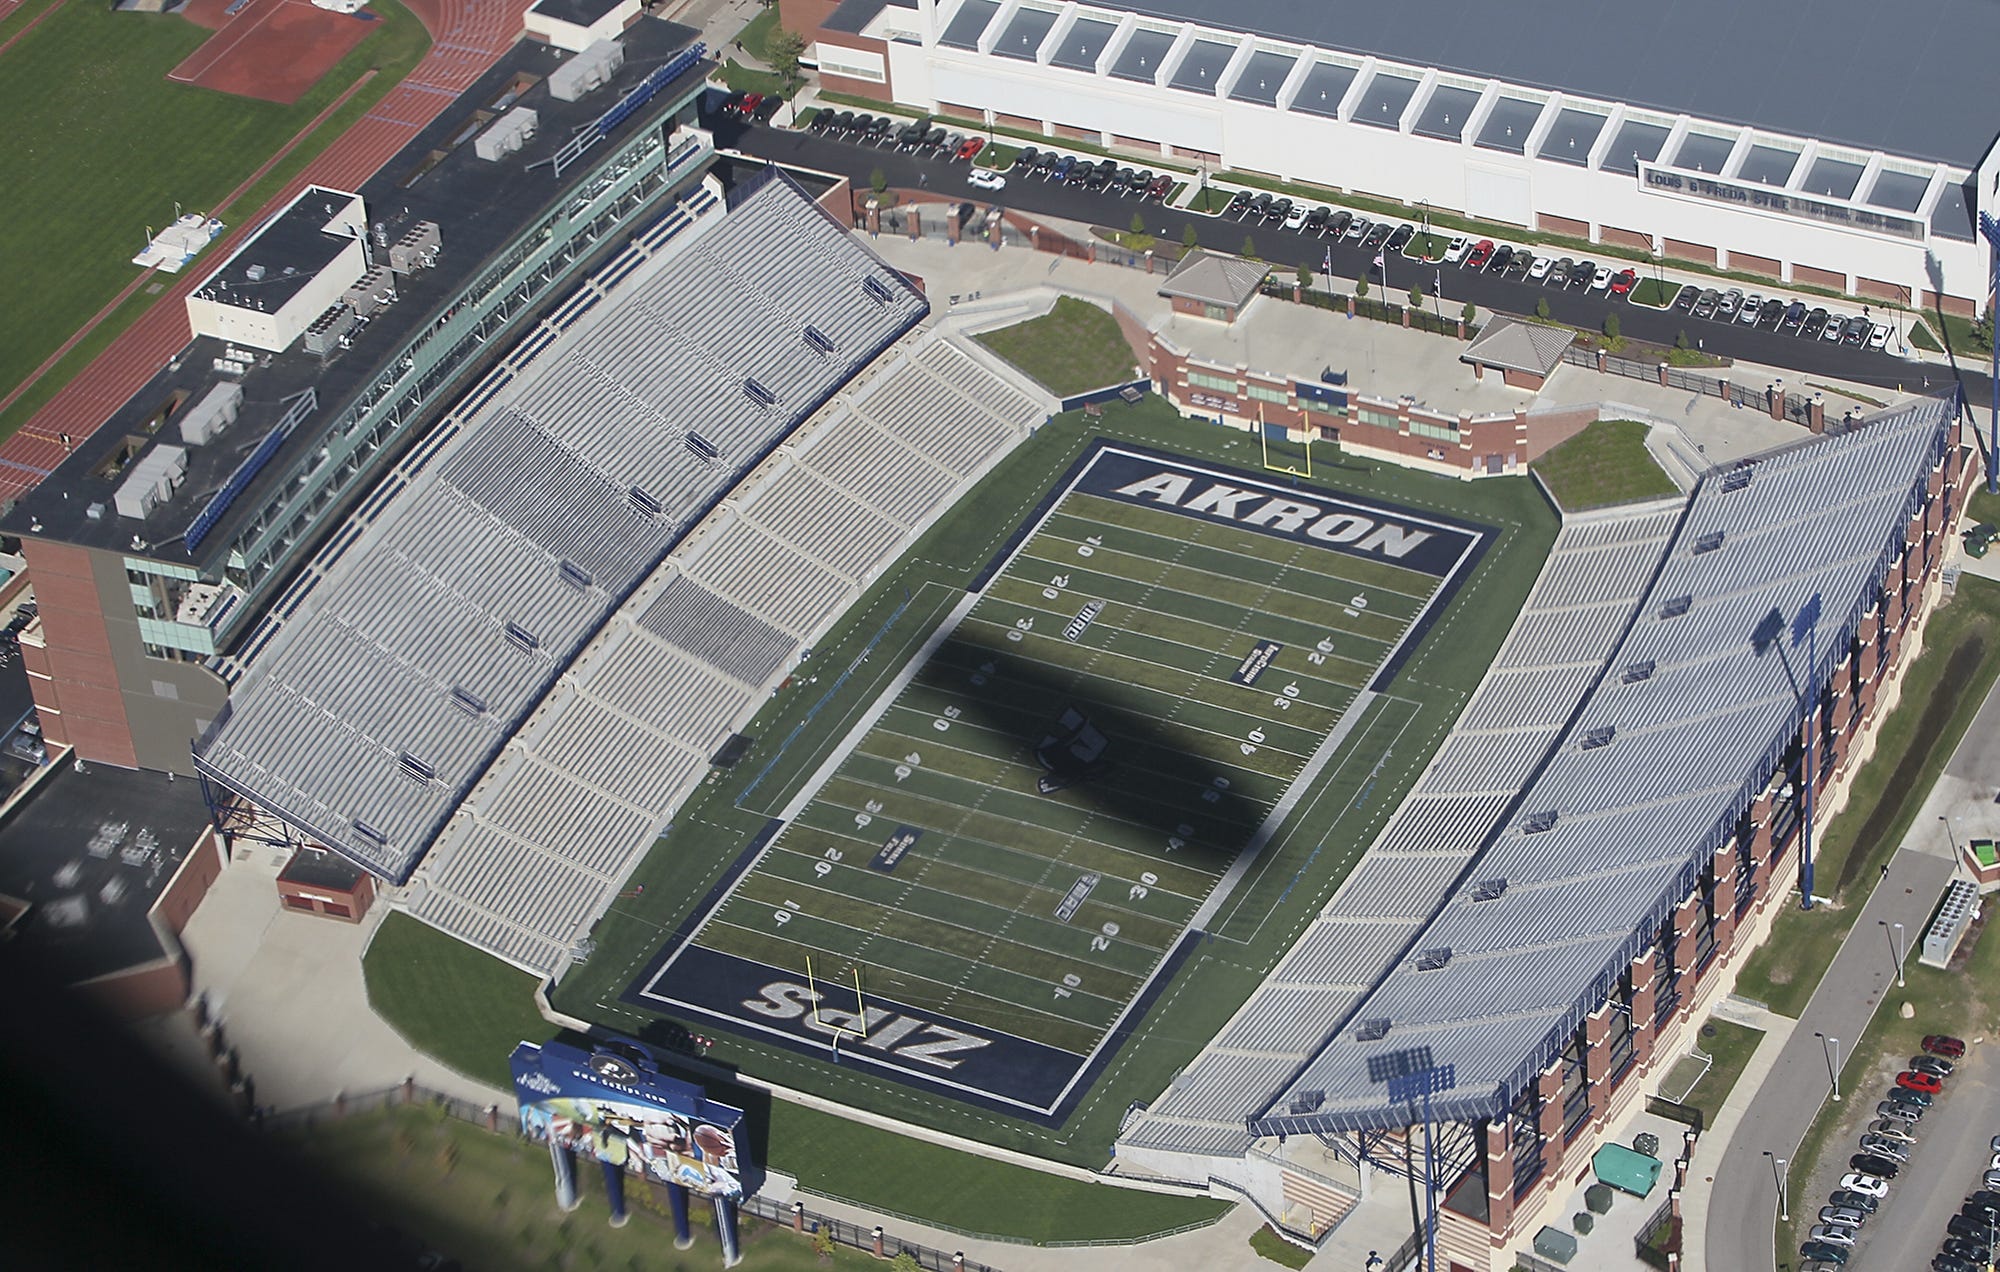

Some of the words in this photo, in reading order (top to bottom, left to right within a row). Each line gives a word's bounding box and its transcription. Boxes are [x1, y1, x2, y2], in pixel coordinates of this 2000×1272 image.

[1647, 170, 1682, 189] LOUIS
[1706, 184, 1747, 202] FREDA
[1110, 472, 1435, 558] AKRON
[1077, 536, 1102, 557] 10
[1042, 575, 1067, 600] 20
[1344, 596, 1367, 617] 10
[1006, 618, 1032, 642] 30
[1067, 606, 1095, 639] MAC
[1308, 639, 1334, 665] 20
[1274, 685, 1299, 710] 30
[933, 705, 961, 731] 50
[1240, 730, 1265, 756] 40
[894, 752, 920, 778] 40
[855, 799, 883, 826] 30
[814, 848, 843, 875] 20
[1129, 871, 1158, 899] 30
[774, 900, 801, 923] 10
[1091, 921, 1120, 951] 20
[1054, 973, 1081, 998] 10
[741, 981, 994, 1069] ZIPS
